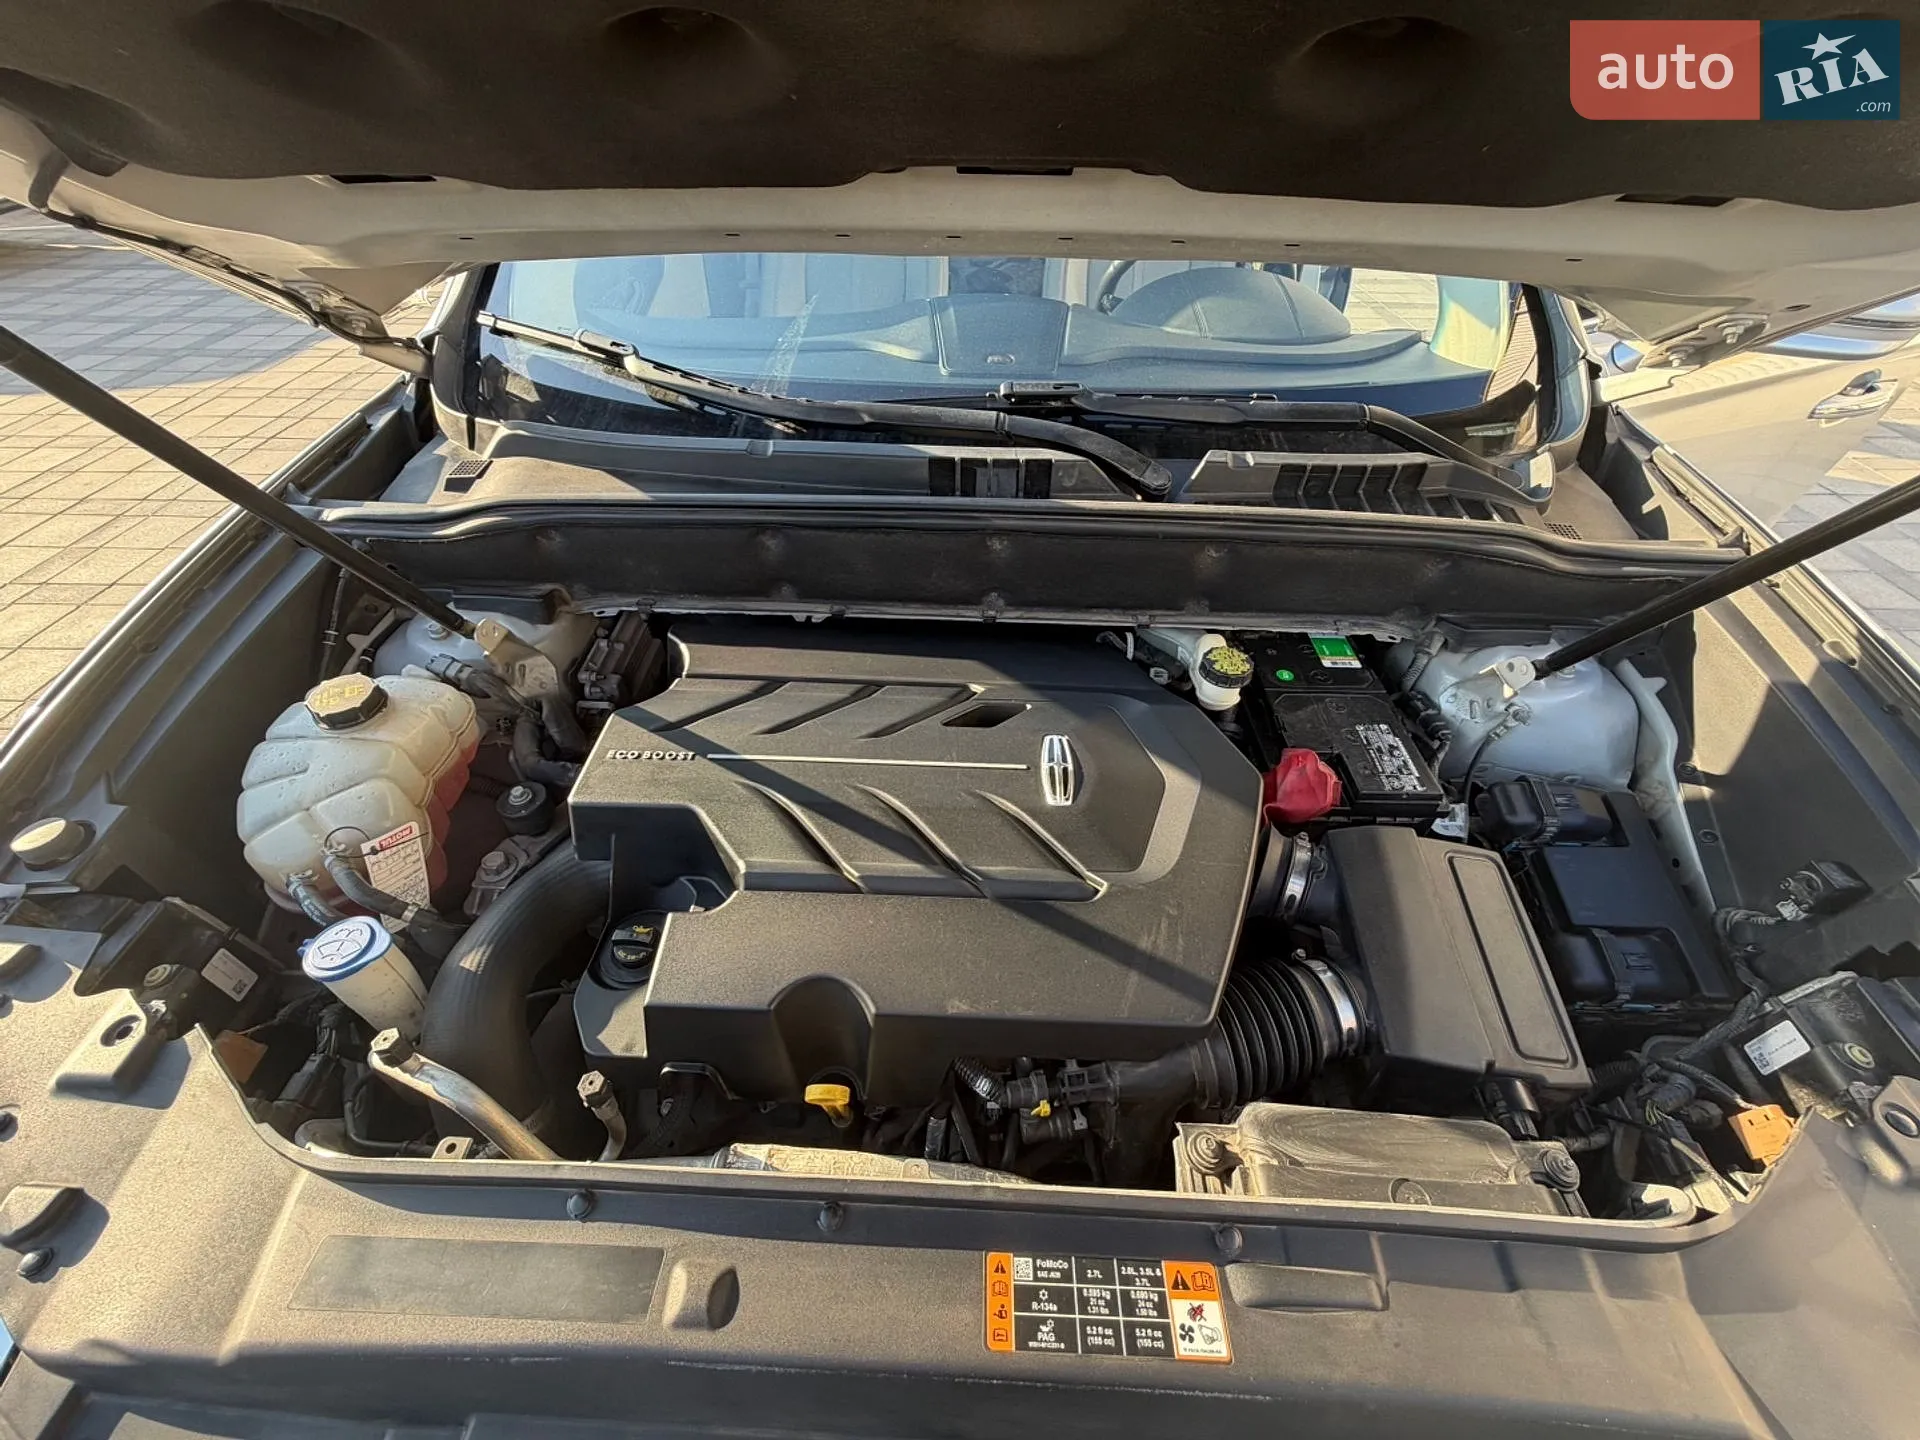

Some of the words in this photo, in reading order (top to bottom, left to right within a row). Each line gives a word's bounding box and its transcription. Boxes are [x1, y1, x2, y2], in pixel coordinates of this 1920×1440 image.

[1036, 1259, 1069, 1269] FoMoCo
[1031, 1302, 1057, 1311] R-134a
[1037, 1332, 1056, 1342] PAG
